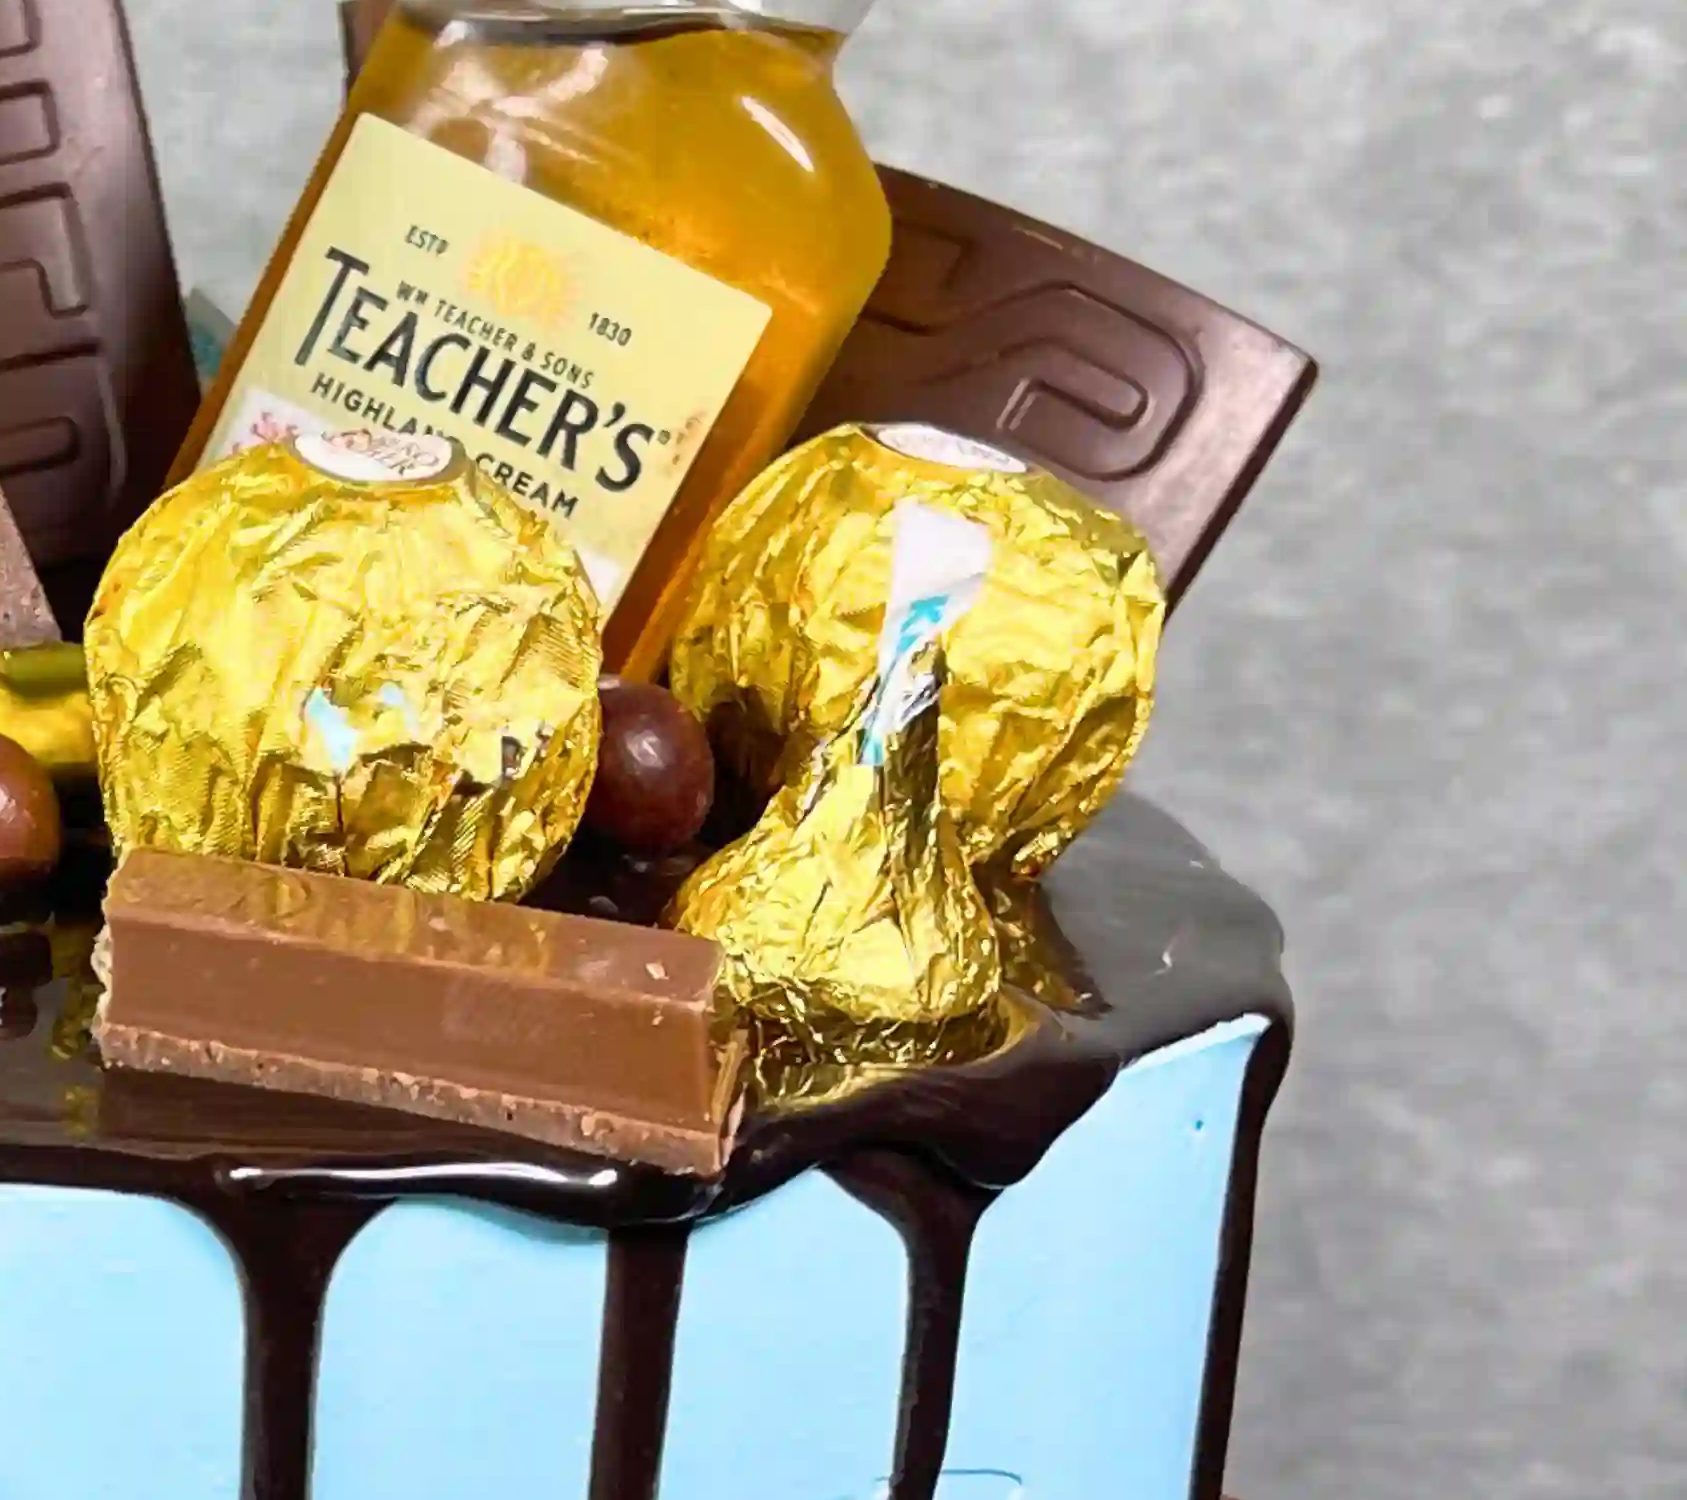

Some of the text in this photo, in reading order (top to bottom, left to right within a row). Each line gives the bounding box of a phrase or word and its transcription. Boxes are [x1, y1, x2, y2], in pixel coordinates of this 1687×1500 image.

[434, 299, 516, 353] TEACHER
[522, 342, 537, 362] &
[540, 351, 595, 389] SONS
[588, 312, 633, 347] 1830
[475, 452, 580, 520] CREAM
